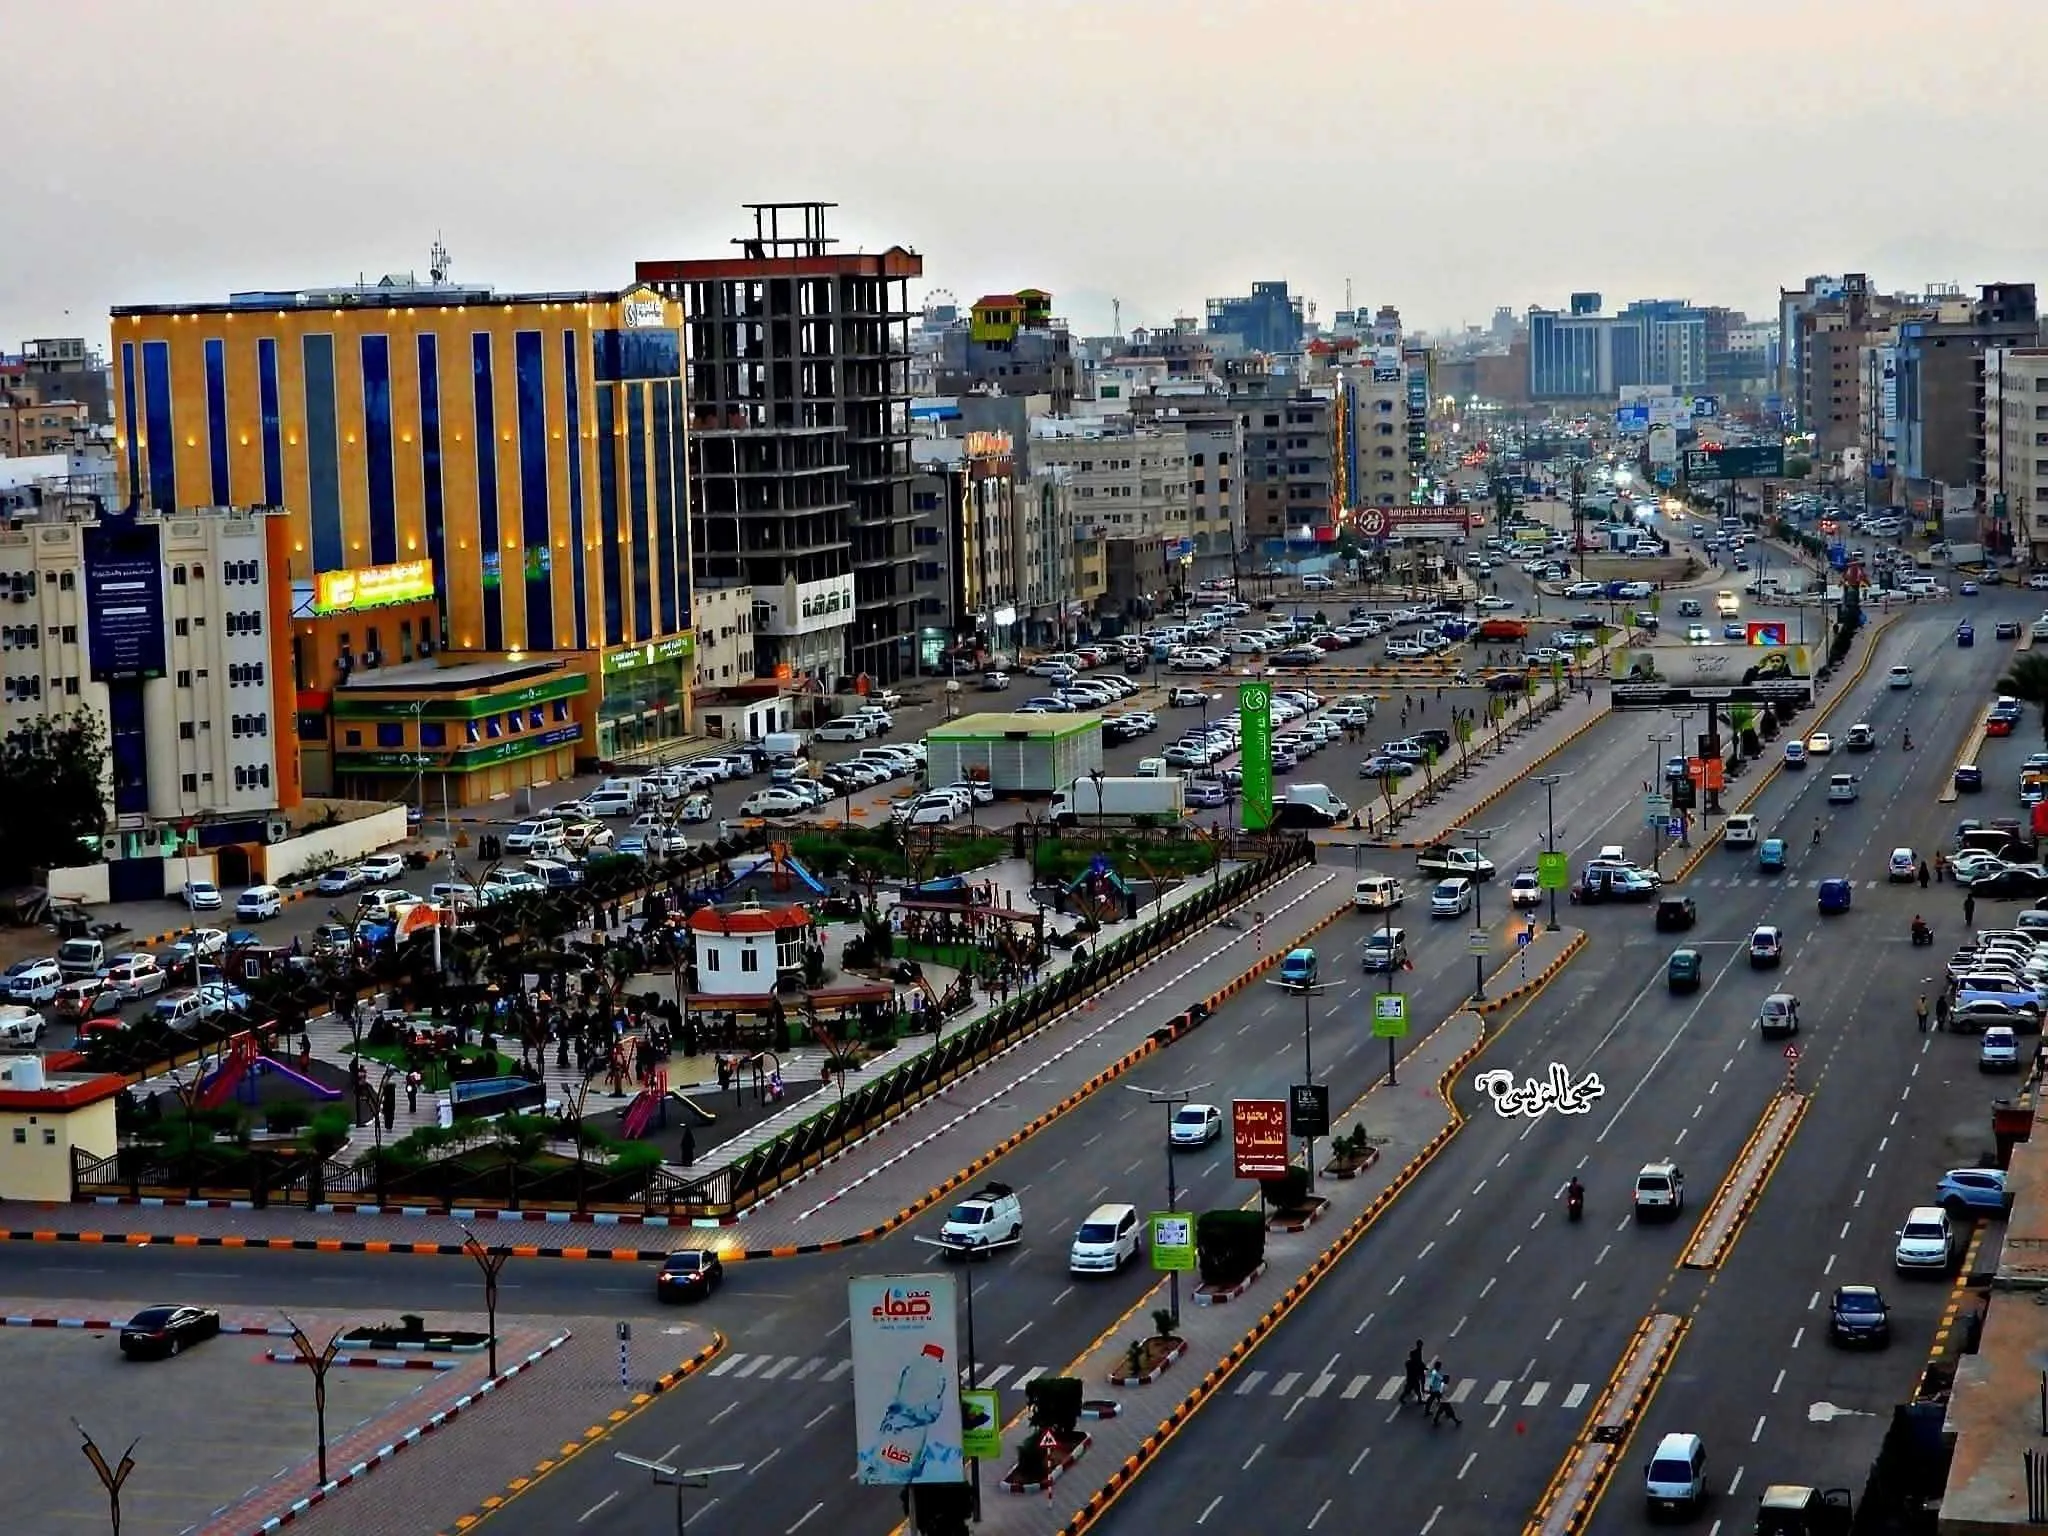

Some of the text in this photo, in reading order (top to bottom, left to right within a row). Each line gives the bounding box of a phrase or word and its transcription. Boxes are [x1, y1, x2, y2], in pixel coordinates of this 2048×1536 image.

[1443, 507, 1466, 516] شركة
[1235, 1104, 1283, 1125] بن محفوظ
[906, 1289, 931, 1298] عدن
[872, 1286, 931, 1317] صفاء
